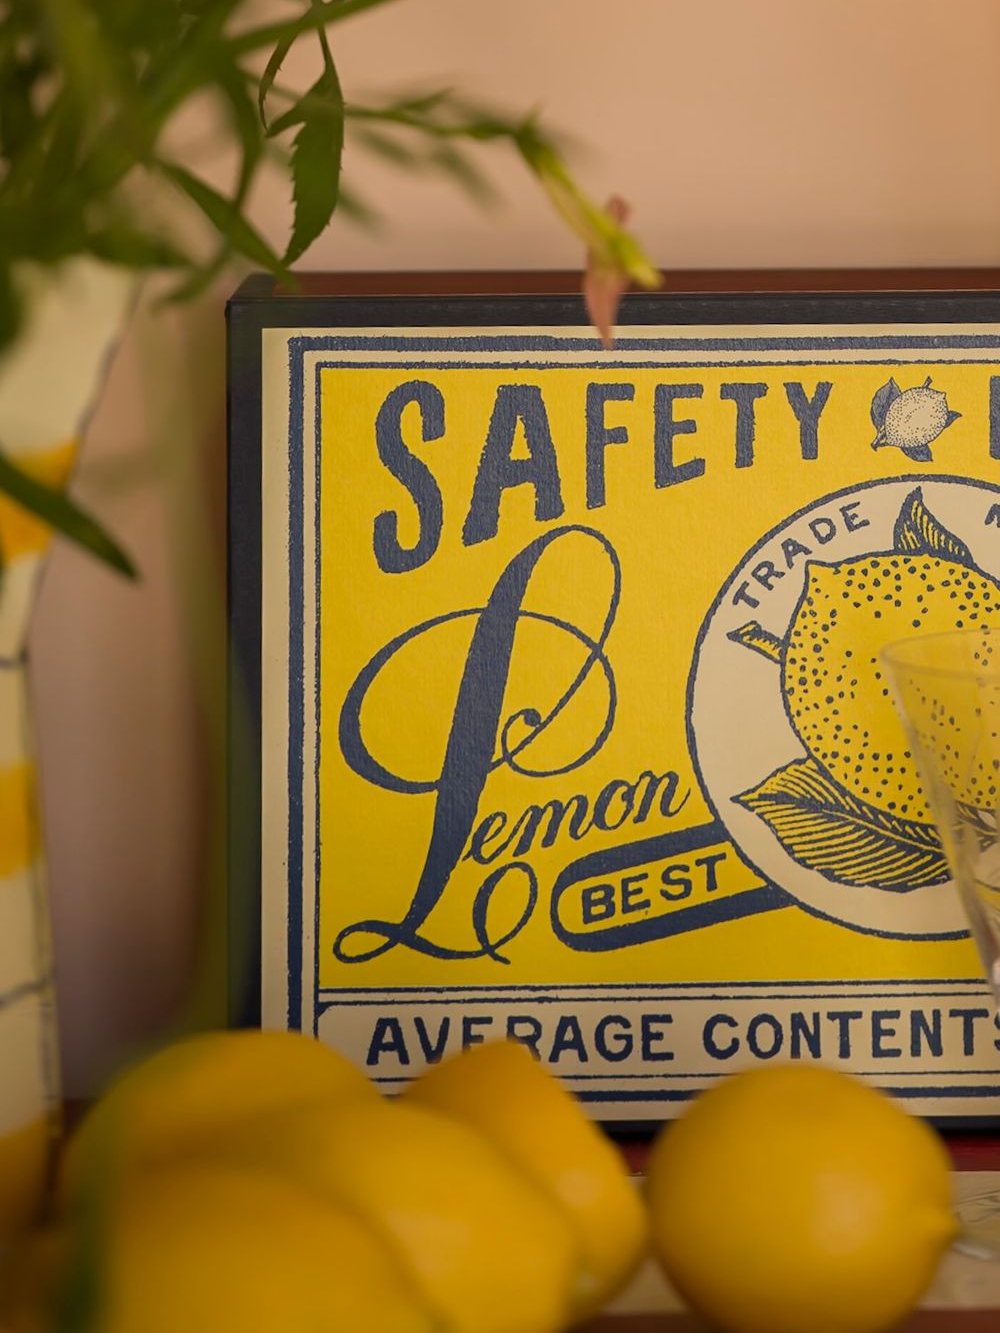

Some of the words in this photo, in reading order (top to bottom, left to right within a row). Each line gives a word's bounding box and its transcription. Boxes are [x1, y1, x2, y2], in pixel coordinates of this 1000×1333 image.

[372, 379, 834, 575] SAFETY
[732, 500, 871, 612] TRADE
[333, 524, 692, 965] Lemon
[581, 852, 728, 926] BEST
[366, 1013, 675, 1065] AVERAGE
